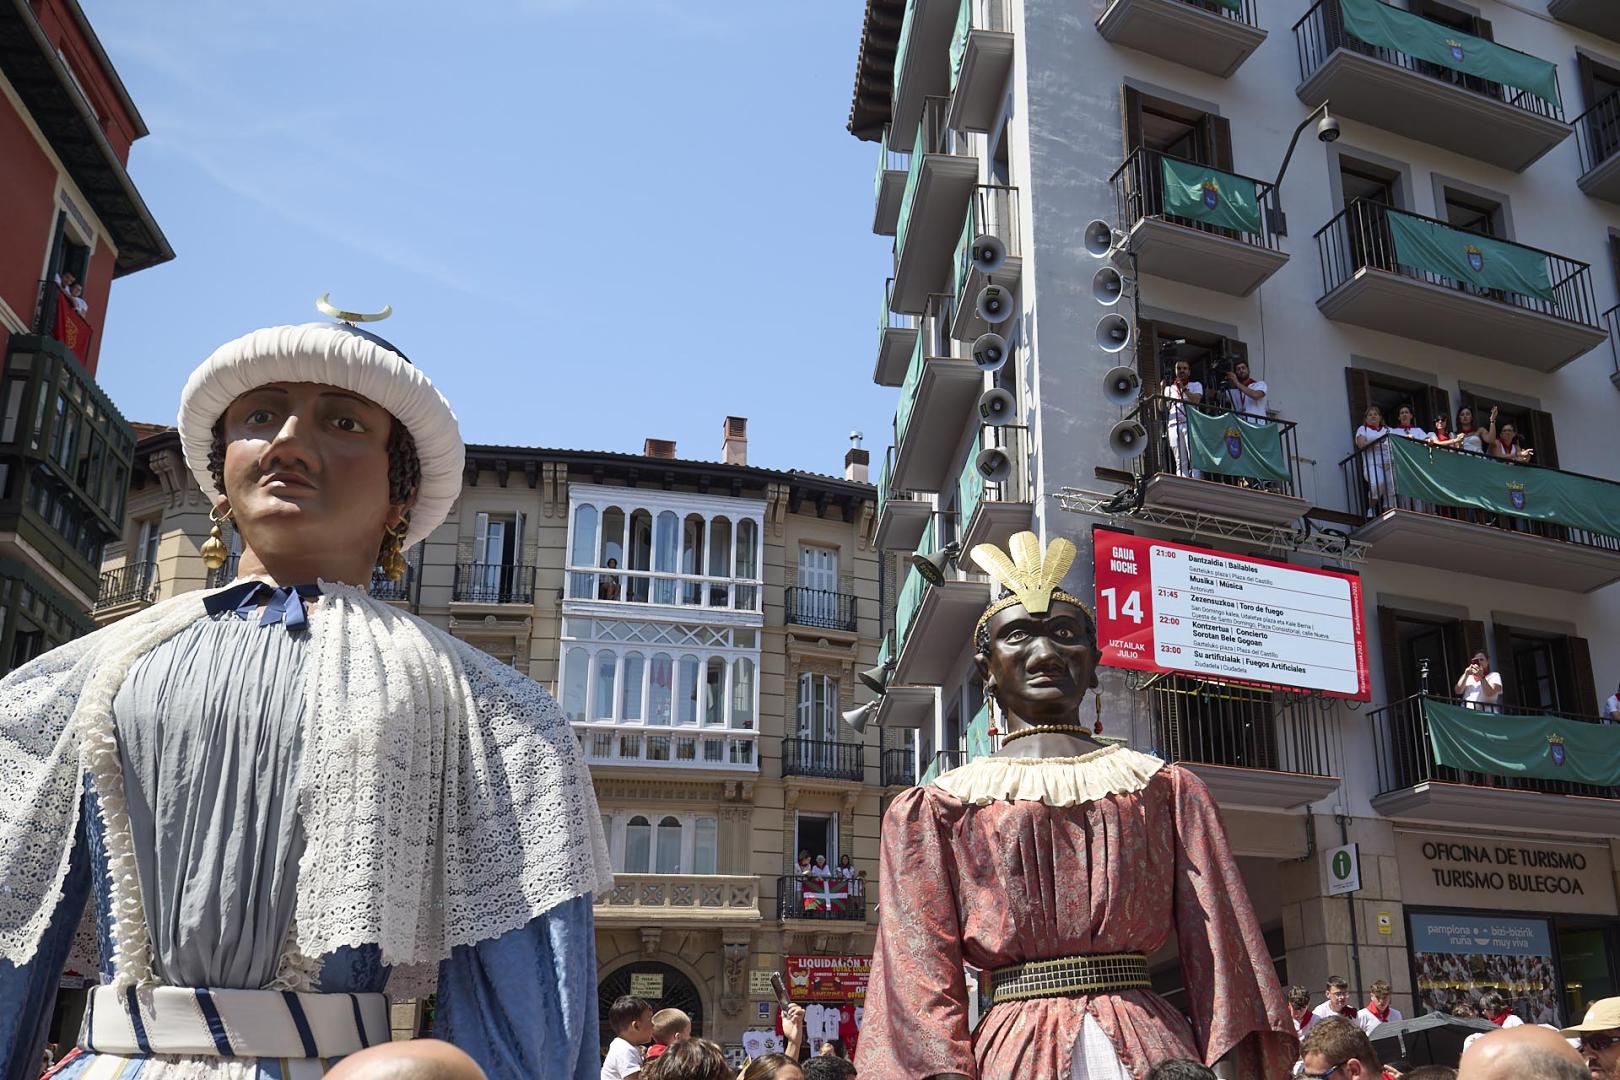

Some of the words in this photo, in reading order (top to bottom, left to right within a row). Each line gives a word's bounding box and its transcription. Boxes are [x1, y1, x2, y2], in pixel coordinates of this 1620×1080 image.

[1112, 546, 1134, 561] GAUA
[1156, 549, 1176, 559] 21:00
[1110, 560, 1138, 575] NOCHE
[1188, 555, 1223, 567] Dantzaldia
[1229, 562, 1258, 573] Bailables
[1190, 575, 1214, 585] Musika
[1219, 580, 1243, 590] Música
[1158, 589, 1178, 598] 21:45
[1101, 588, 1144, 624] 14
[1191, 595, 1235, 608] Zezensuzkoa
[1240, 603, 1255, 611] Toro
[1265, 607, 1284, 617] fuego
[1160, 616, 1180, 625] 22:00
[1192, 622, 1229, 633] Kontzertua
[1236, 628, 1268, 639] Concierto
[1109, 640, 1145, 652] UZTAILAK
[1193, 630, 1219, 640] Sorotan
[1221, 634, 1236, 642] Bele
[1237, 637, 1263, 648] Gogoan
[1116, 650, 1138, 660] JULIO
[1161, 645, 1182, 654] 23:00
[1205, 652, 1241, 664] artifizialak
[1246, 658, 1269, 669] Fuegos
[1271, 662, 1306, 673] Artificiales
[1422, 842, 1492, 864] OFICINA
[1496, 848, 1518, 866] DE
[1519, 849, 1586, 870] TURISMO
[1432, 868, 1504, 890] TURISMO
[1508, 874, 1584, 895] BULEGOA
[1428, 924, 1470, 935] pamplona
[1450, 935, 1472, 945] iruña
[1492, 939, 1511, 949] muy
[1512, 938, 1529, 948] viva
